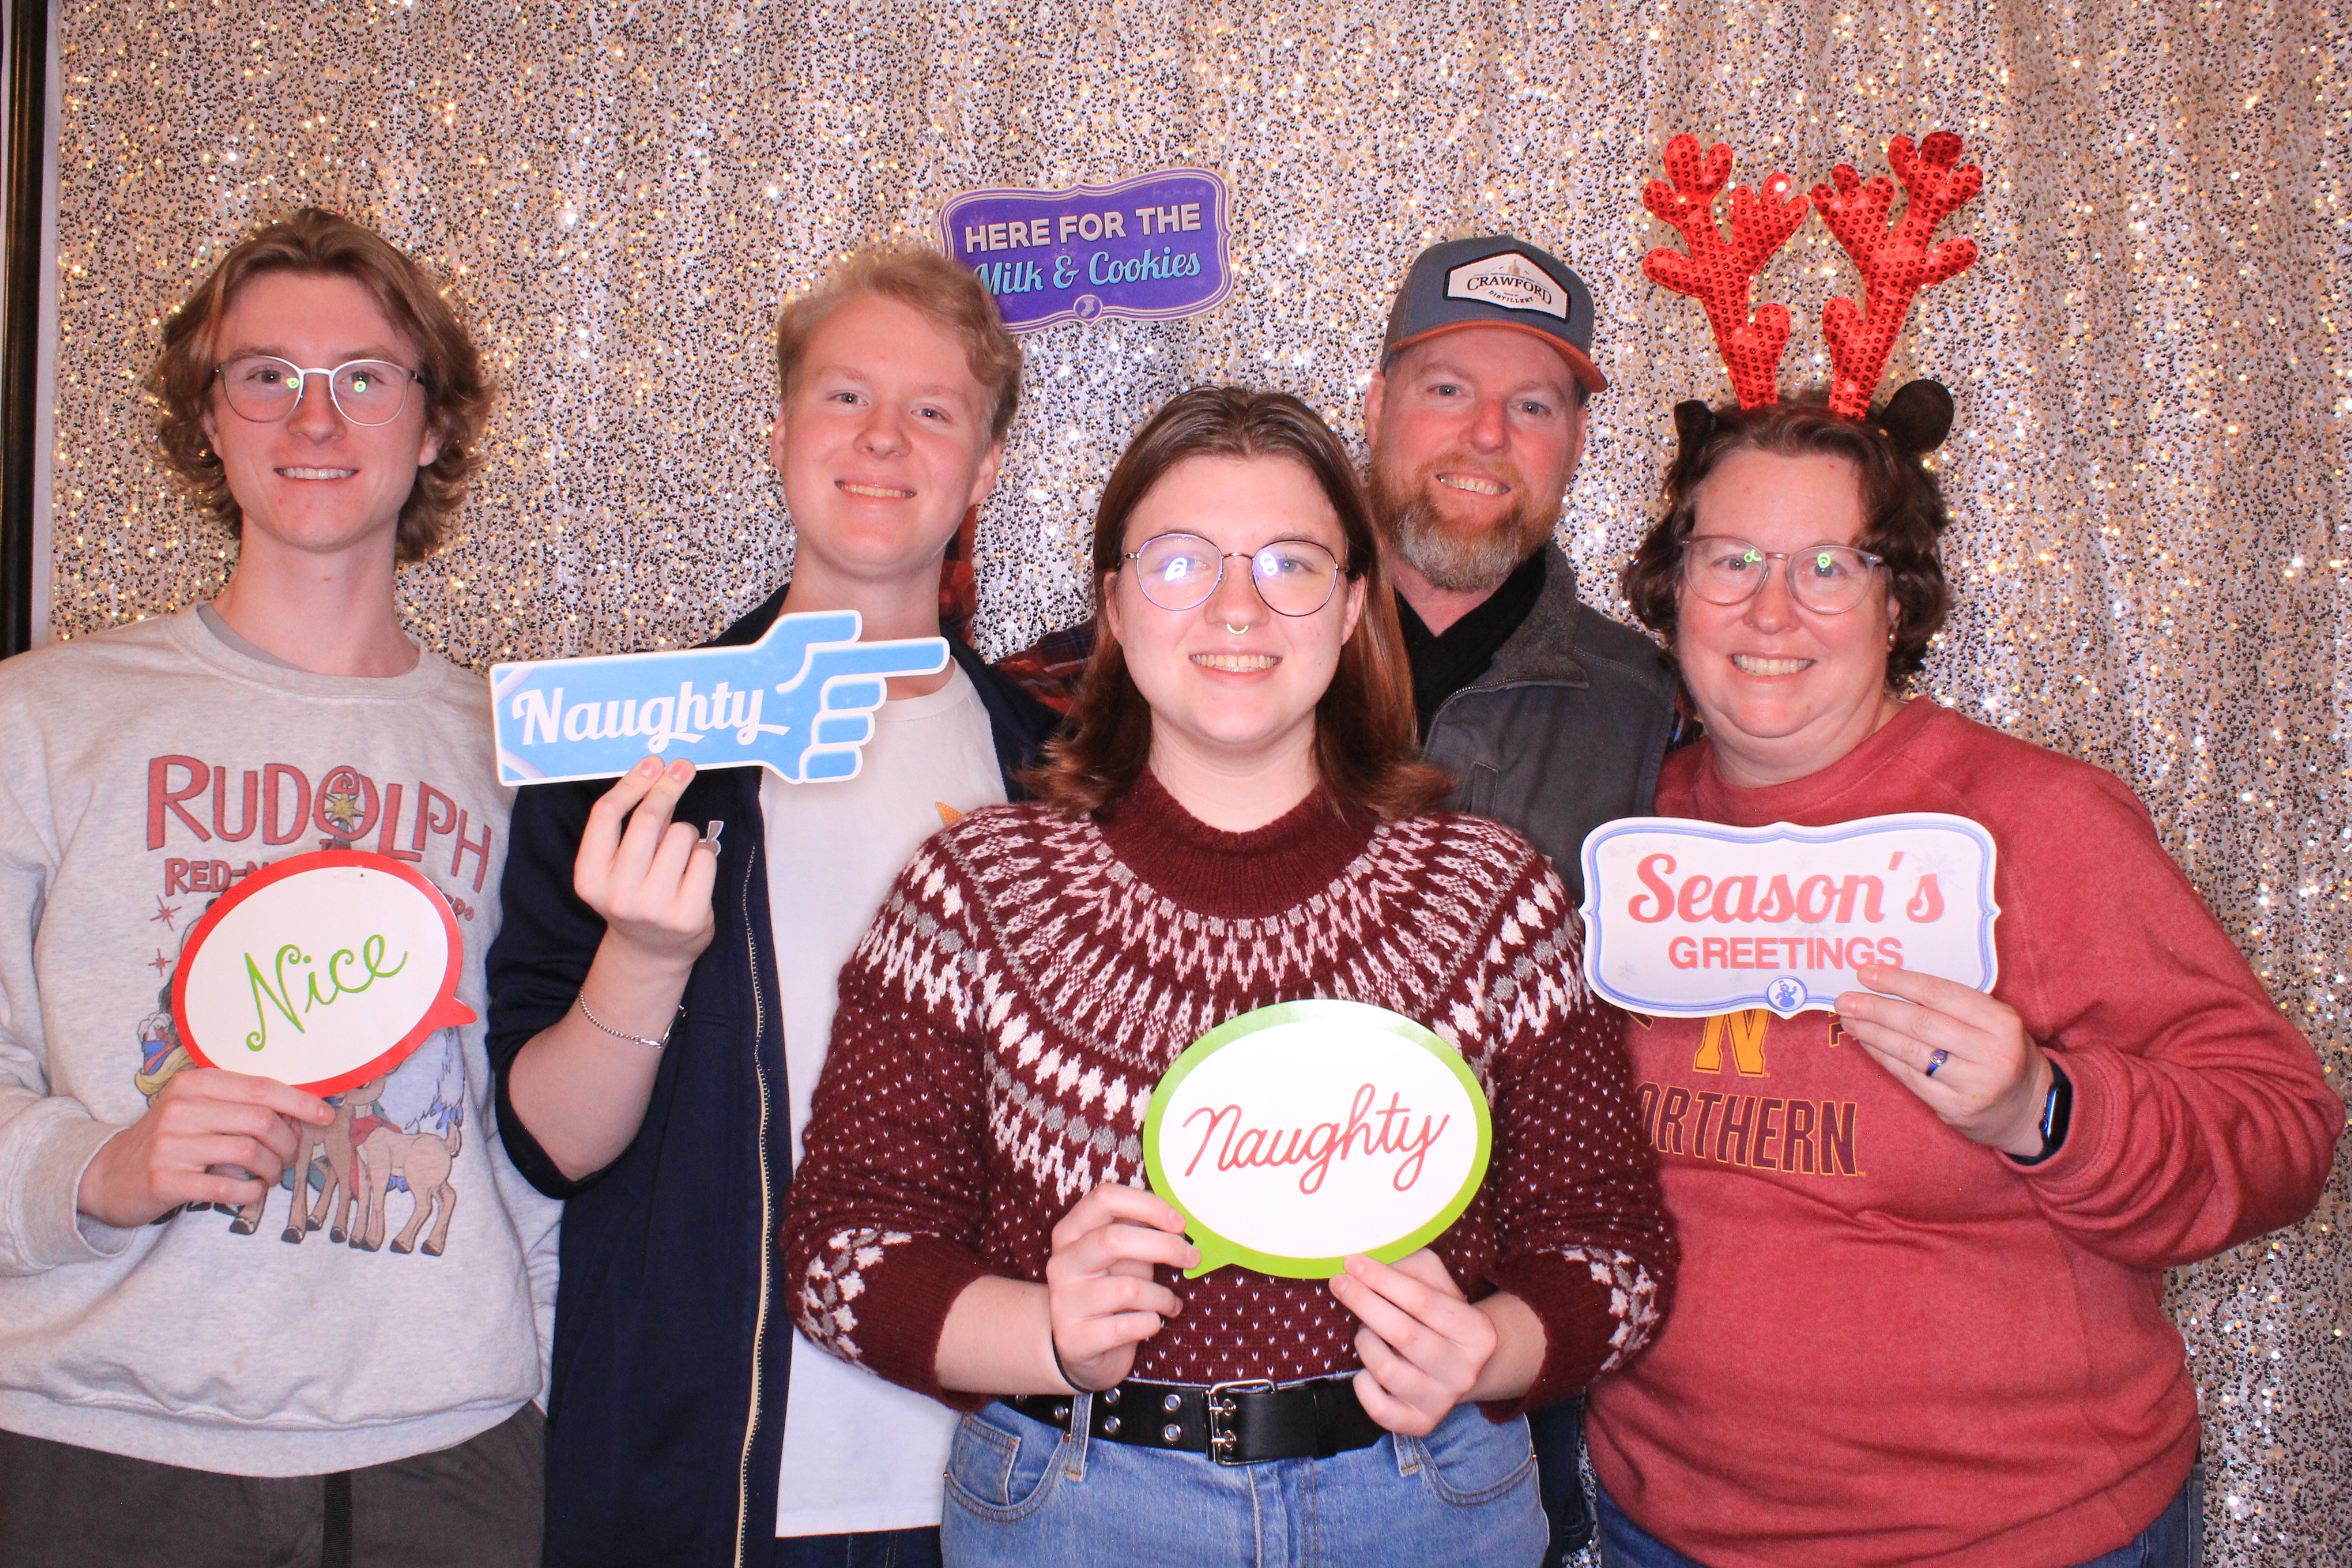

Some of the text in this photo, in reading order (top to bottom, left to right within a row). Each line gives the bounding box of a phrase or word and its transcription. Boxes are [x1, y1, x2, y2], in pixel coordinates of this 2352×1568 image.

[965, 203, 1201, 253] HERE FOR THE
[976, 246, 1200, 295] Milk & Cookies
[1467, 276, 1552, 305] CRAWFORD
[1488, 289, 1534, 304] DISTILLERY
[512, 681, 791, 753] Naughty
[146, 754, 491, 893] RUDOLPH
[165, 858, 270, 896] RED-
[1628, 851, 1945, 924] Season's
[1668, 936, 1904, 970] GREETINGS
[246, 934, 408, 1051] Nice
[1182, 1083, 1450, 1194] Naughty
[1635, 1081, 1858, 1176] ORTHERN
